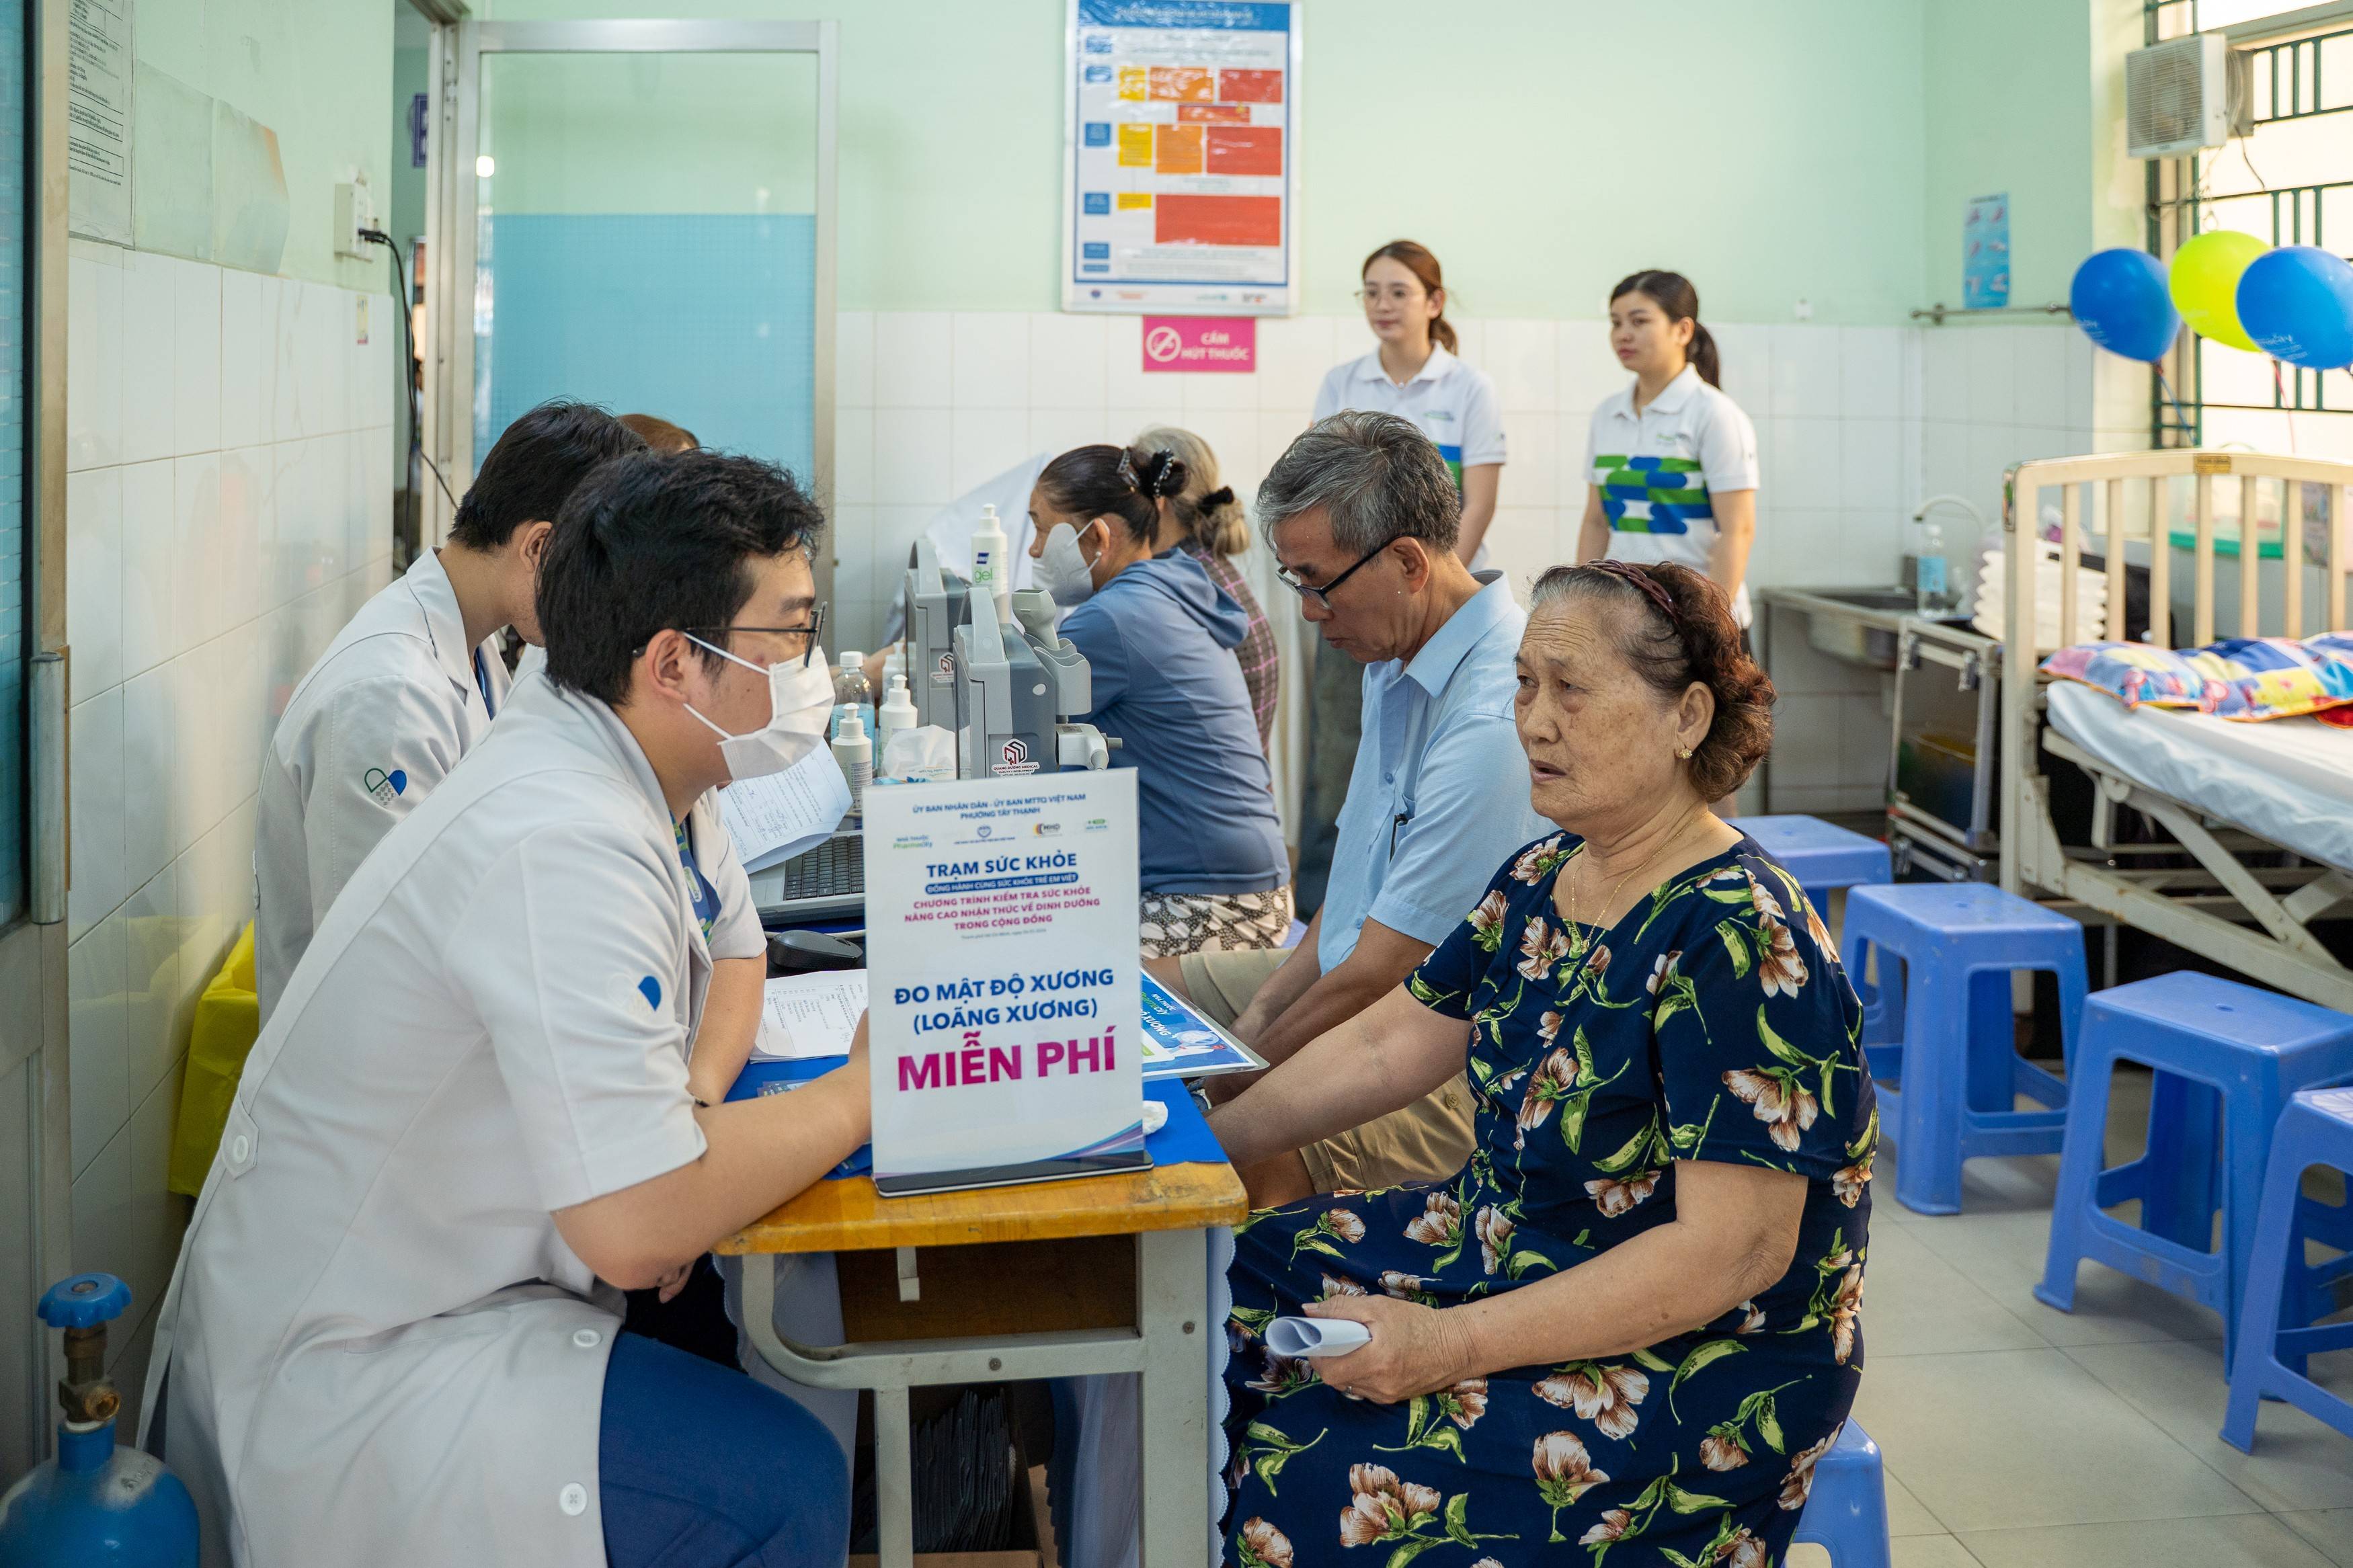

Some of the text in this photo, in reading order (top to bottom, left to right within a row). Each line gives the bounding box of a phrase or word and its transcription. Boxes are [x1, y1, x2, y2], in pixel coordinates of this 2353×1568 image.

[974, 567, 993, 583] gel
[1067, 793, 1086, 801] NAM
[926, 850, 1077, 880] TRẠM SỨC KHỎE
[1049, 874, 1061, 882] EM
[1062, 873, 1077, 882] VIỆT
[960, 895, 990, 906] TRÌNH
[1021, 892, 1039, 901] TRA
[1042, 887, 1061, 898] SỨC
[1064, 885, 1091, 897] KHỎE
[936, 910, 958, 919] CAO
[961, 907, 990, 919] NHẬN
[993, 904, 1019, 915] THỨC
[1021, 901, 1033, 912] VỀ
[1036, 901, 1061, 911] DINH
[953, 913, 1053, 930] TRONG CỘNG ĐỒNG
[894, 968, 1114, 1005] ĐO MẬT ĐỘ XƯƠNG
[914, 998, 1098, 1035] (LOÃNG XƯƠNG)
[1143, 1015, 1171, 1036] XƯƠNG
[898, 1025, 1117, 1091] MIỄN PHÍ
